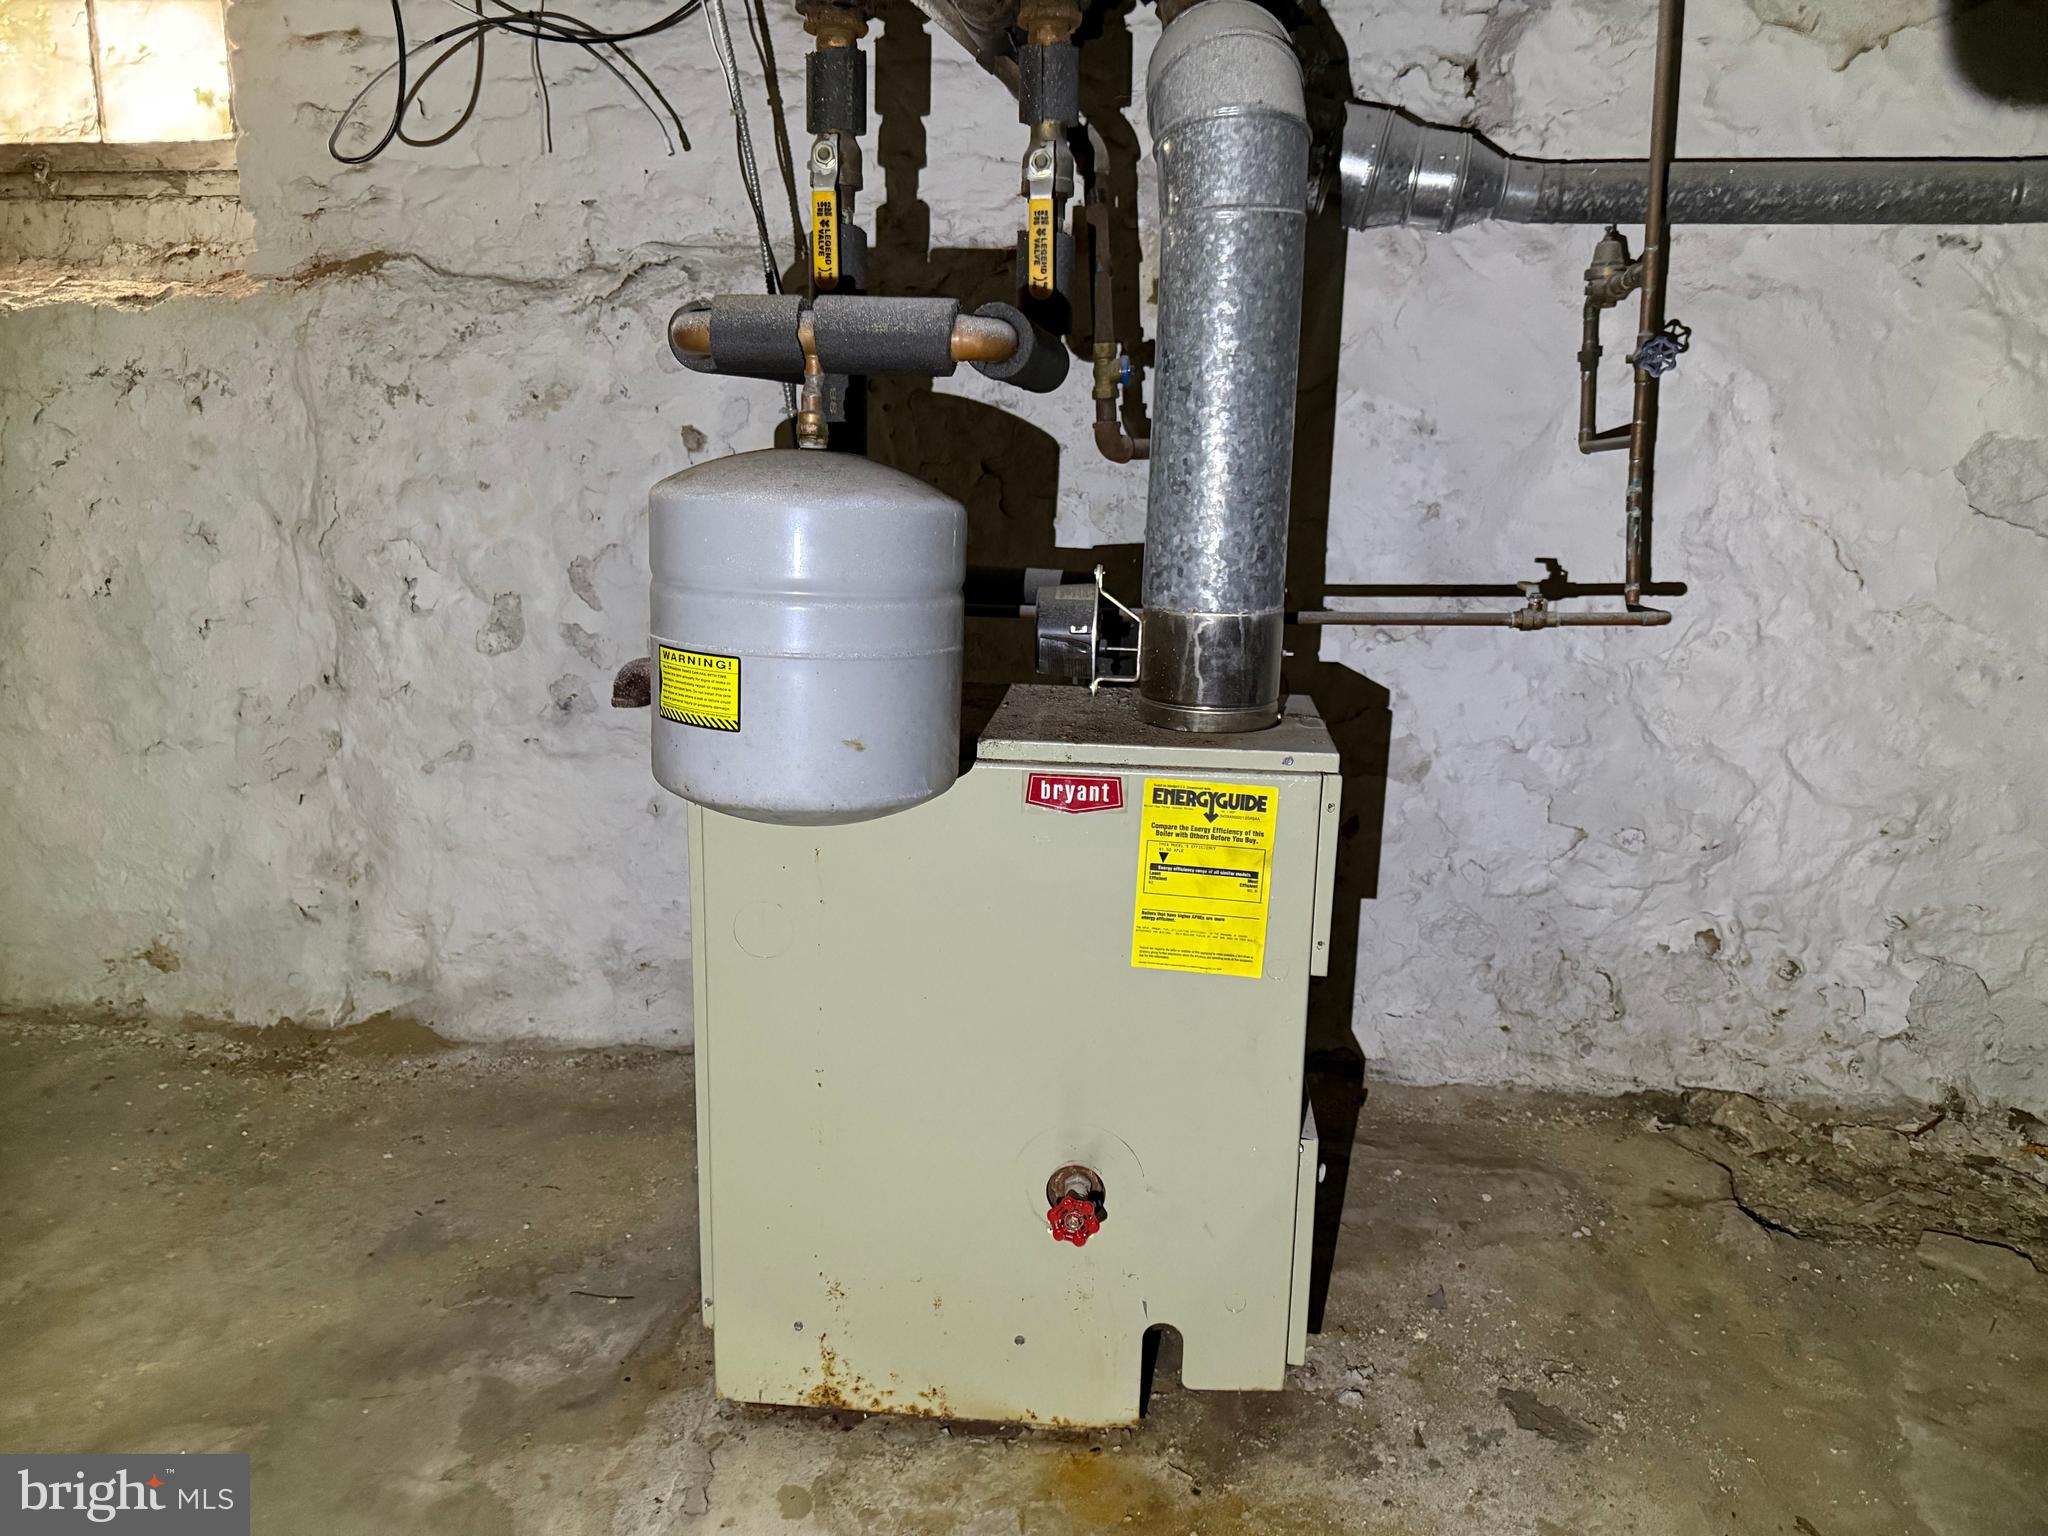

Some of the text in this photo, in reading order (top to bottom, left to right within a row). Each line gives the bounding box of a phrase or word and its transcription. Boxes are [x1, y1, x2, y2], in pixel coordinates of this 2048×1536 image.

[663, 650, 732, 670] WARNING!
[1040, 780, 1109, 804] bryant
[1153, 788, 1267, 812] ENERGYGUIDE
[1151, 822, 1177, 830] Compare
[1190, 825, 1210, 834] Energy
[1212, 827, 1243, 836] Efficiency
[1211, 834, 1230, 842] Before
